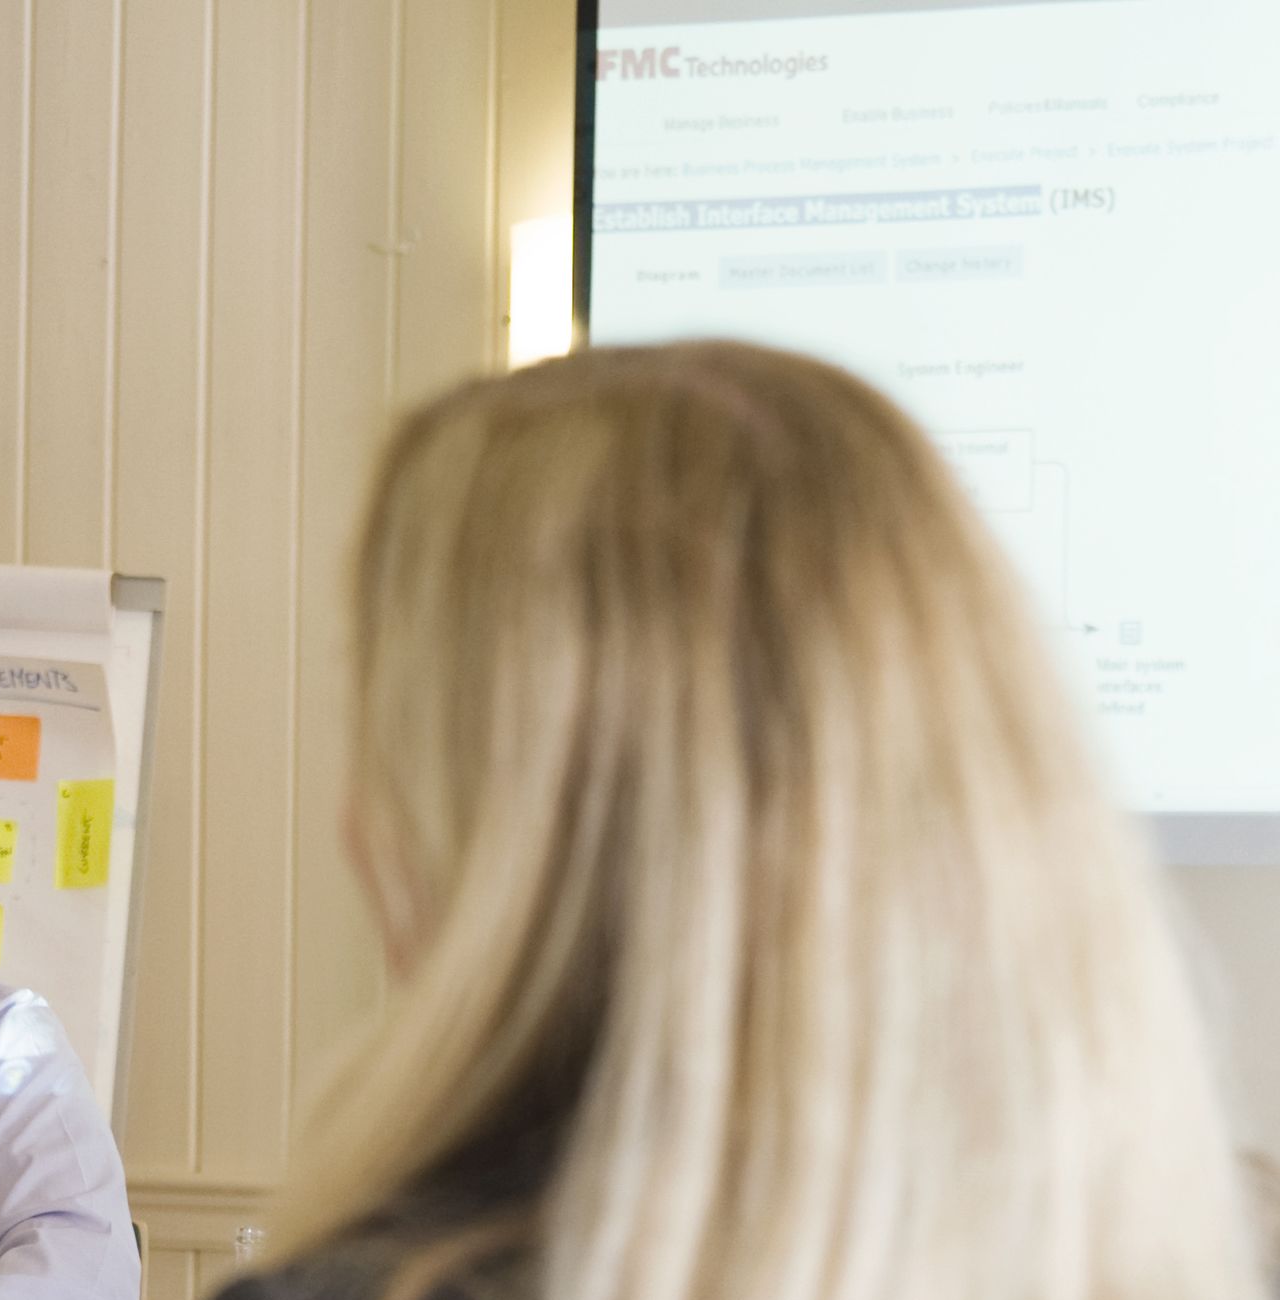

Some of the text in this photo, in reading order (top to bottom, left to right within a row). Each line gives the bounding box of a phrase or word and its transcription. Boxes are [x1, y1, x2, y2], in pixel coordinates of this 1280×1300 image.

[598, 47, 828, 81] FMC Technologies
[1137, 93, 1219, 110] Compliance
[596, 186, 1116, 229] Establish Interface Management System (IMS)
[896, 358, 1024, 380] System Engineer
